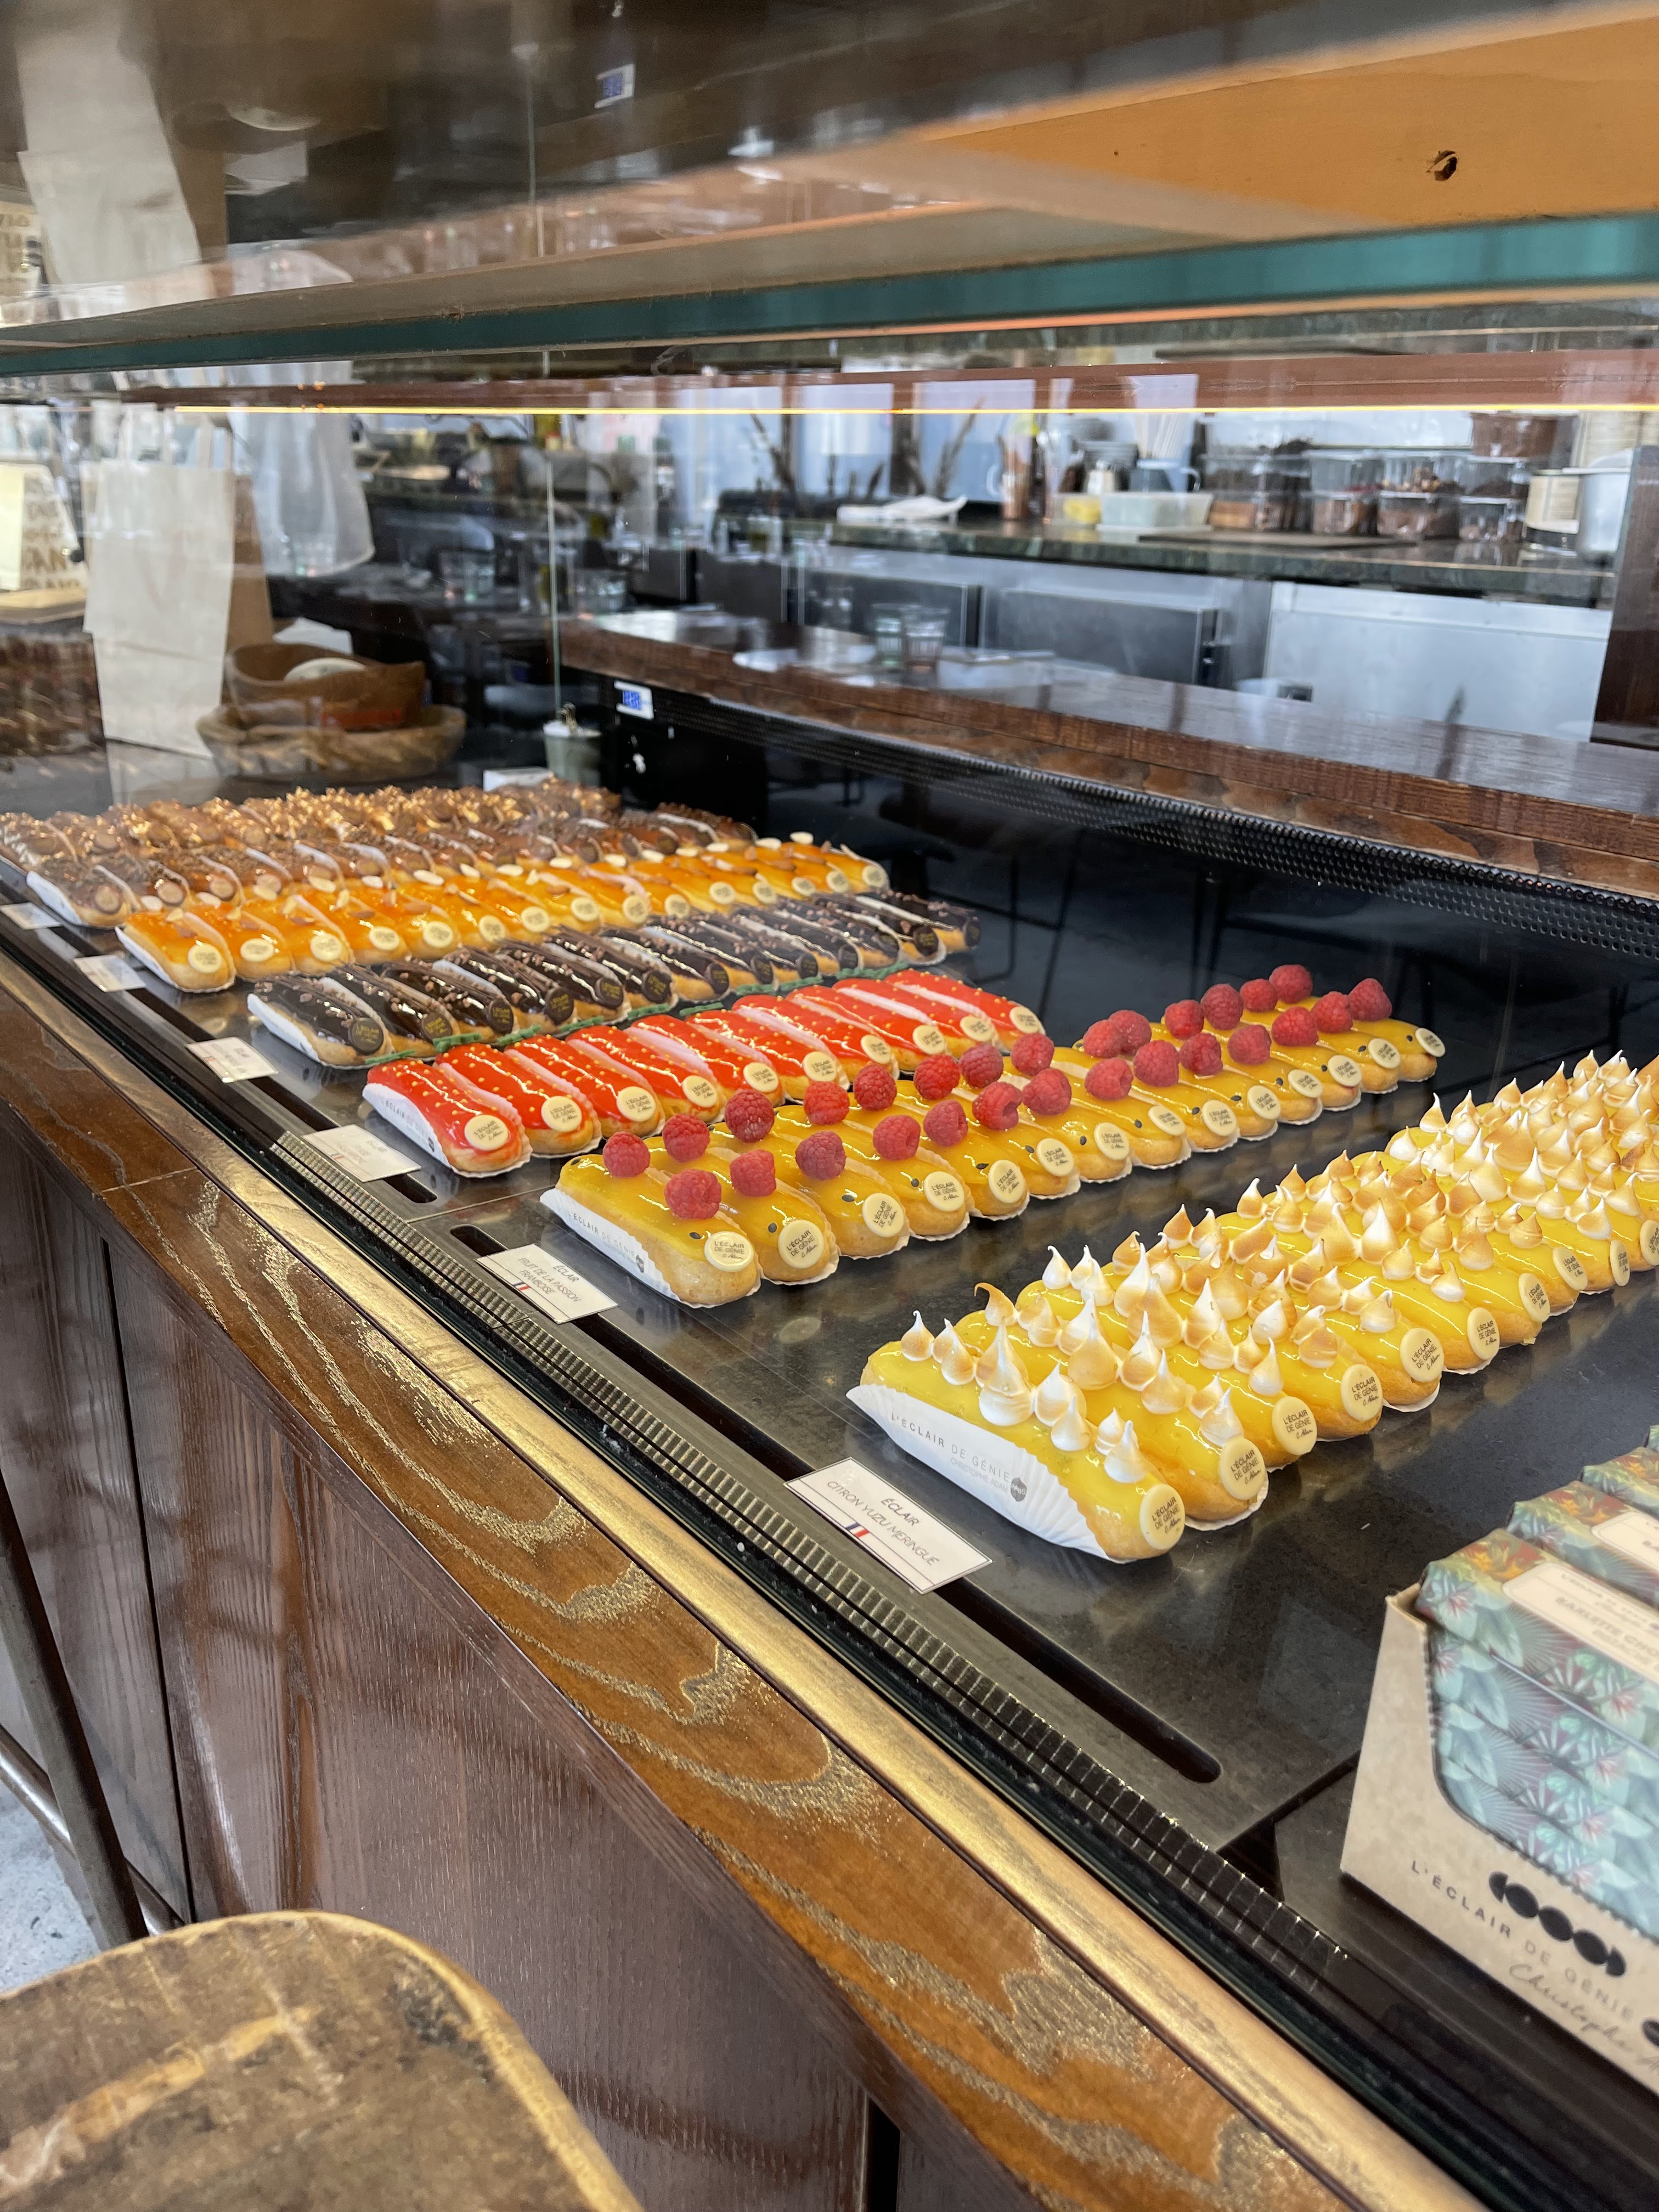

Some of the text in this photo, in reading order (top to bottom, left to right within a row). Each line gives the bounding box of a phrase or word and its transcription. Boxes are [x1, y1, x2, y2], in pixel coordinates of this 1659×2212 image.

[714, 1240, 744, 1249] L'ÉCLAIR
[786, 1230, 811, 1251] L'ÉCLAIR
[798, 1234, 815, 1250] GÉNIE
[1412, 1338, 1432, 1362] L'ÉCLAIR
[1423, 1344, 1437, 1361] GÉNIE
[1351, 1376, 1375, 1393] L'ÉCLAIR
[1362, 1384, 1377, 1396] GÉNIE
[1283, 1409, 1308, 1425] L'ÉCLAIR
[1295, 1417, 1311, 1429] GÉNIE
[891, 1412, 1010, 1483] L'ÉCLAIR DE GÉNIE
[1230, 1449, 1255, 1472] L'ÉCLAIR
[1242, 1457, 1259, 1473] GÉNIE
[950, 1457, 1009, 1493] CHRISTOPHE ADAM
[827, 1481, 864, 1506] CITRON
[861, 1504, 891, 1527] YUZU
[880, 1497, 919, 1527] ÉCLAIR
[1152, 1497, 1176, 1521] L'ÉCLAIR
[1163, 1504, 1180, 1522] GÉNIE
[1412, 1860, 1511, 1939] L'ÉCLAIR
[1524, 1939, 1551, 1965] DE
